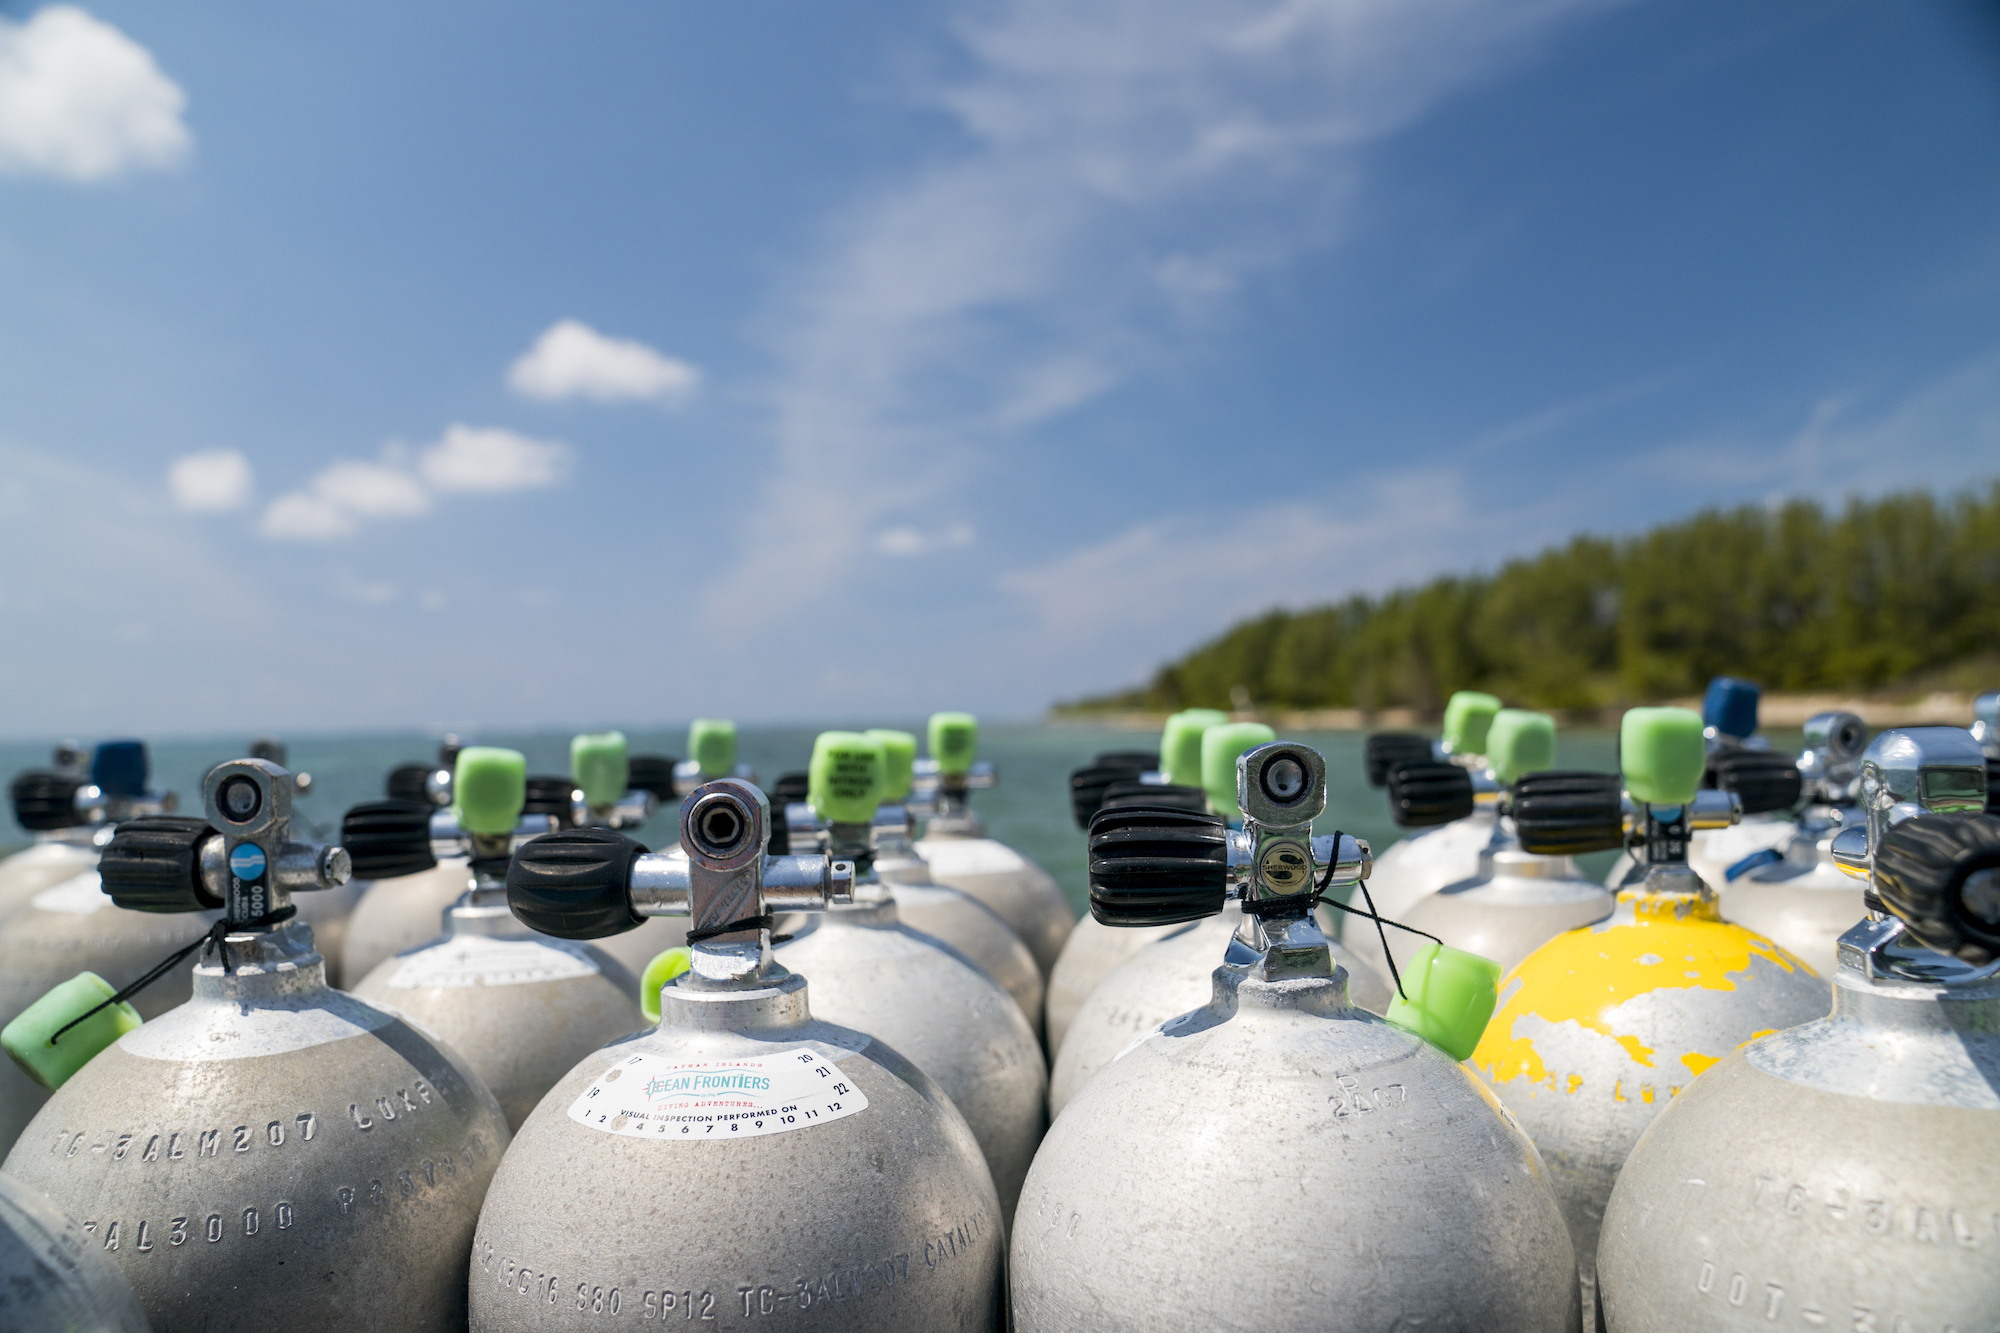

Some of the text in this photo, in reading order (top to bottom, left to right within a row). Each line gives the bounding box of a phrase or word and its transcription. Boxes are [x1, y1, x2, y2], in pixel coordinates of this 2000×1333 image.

[251, 885, 264, 917] 5000
[797, 1054, 813, 1064] 20
[815, 1066, 831, 1078] 21
[647, 1074, 770, 1096] OCEAN FRONTIERS
[833, 1082, 849, 1096] 22
[586, 1086, 600, 1099] 19
[620, 1104, 798, 1122] VISUAL INSPECTION PERFORMED ON
[657, 1102, 689, 1111] DIVING
[598, 1115, 607, 1123] 2
[636, 1122, 645, 1131] 4
[658, 1124, 667, 1133] 5
[681, 1125, 690, 1134] 6
[706, 1125, 714, 1133] 7
[731, 1123, 739, 1132] 8
[755, 1120, 763, 1129] 9
[780, 1115, 796, 1125] 10
[804, 1109, 819, 1119] 11
[827, 1102, 843, 1112] 12
